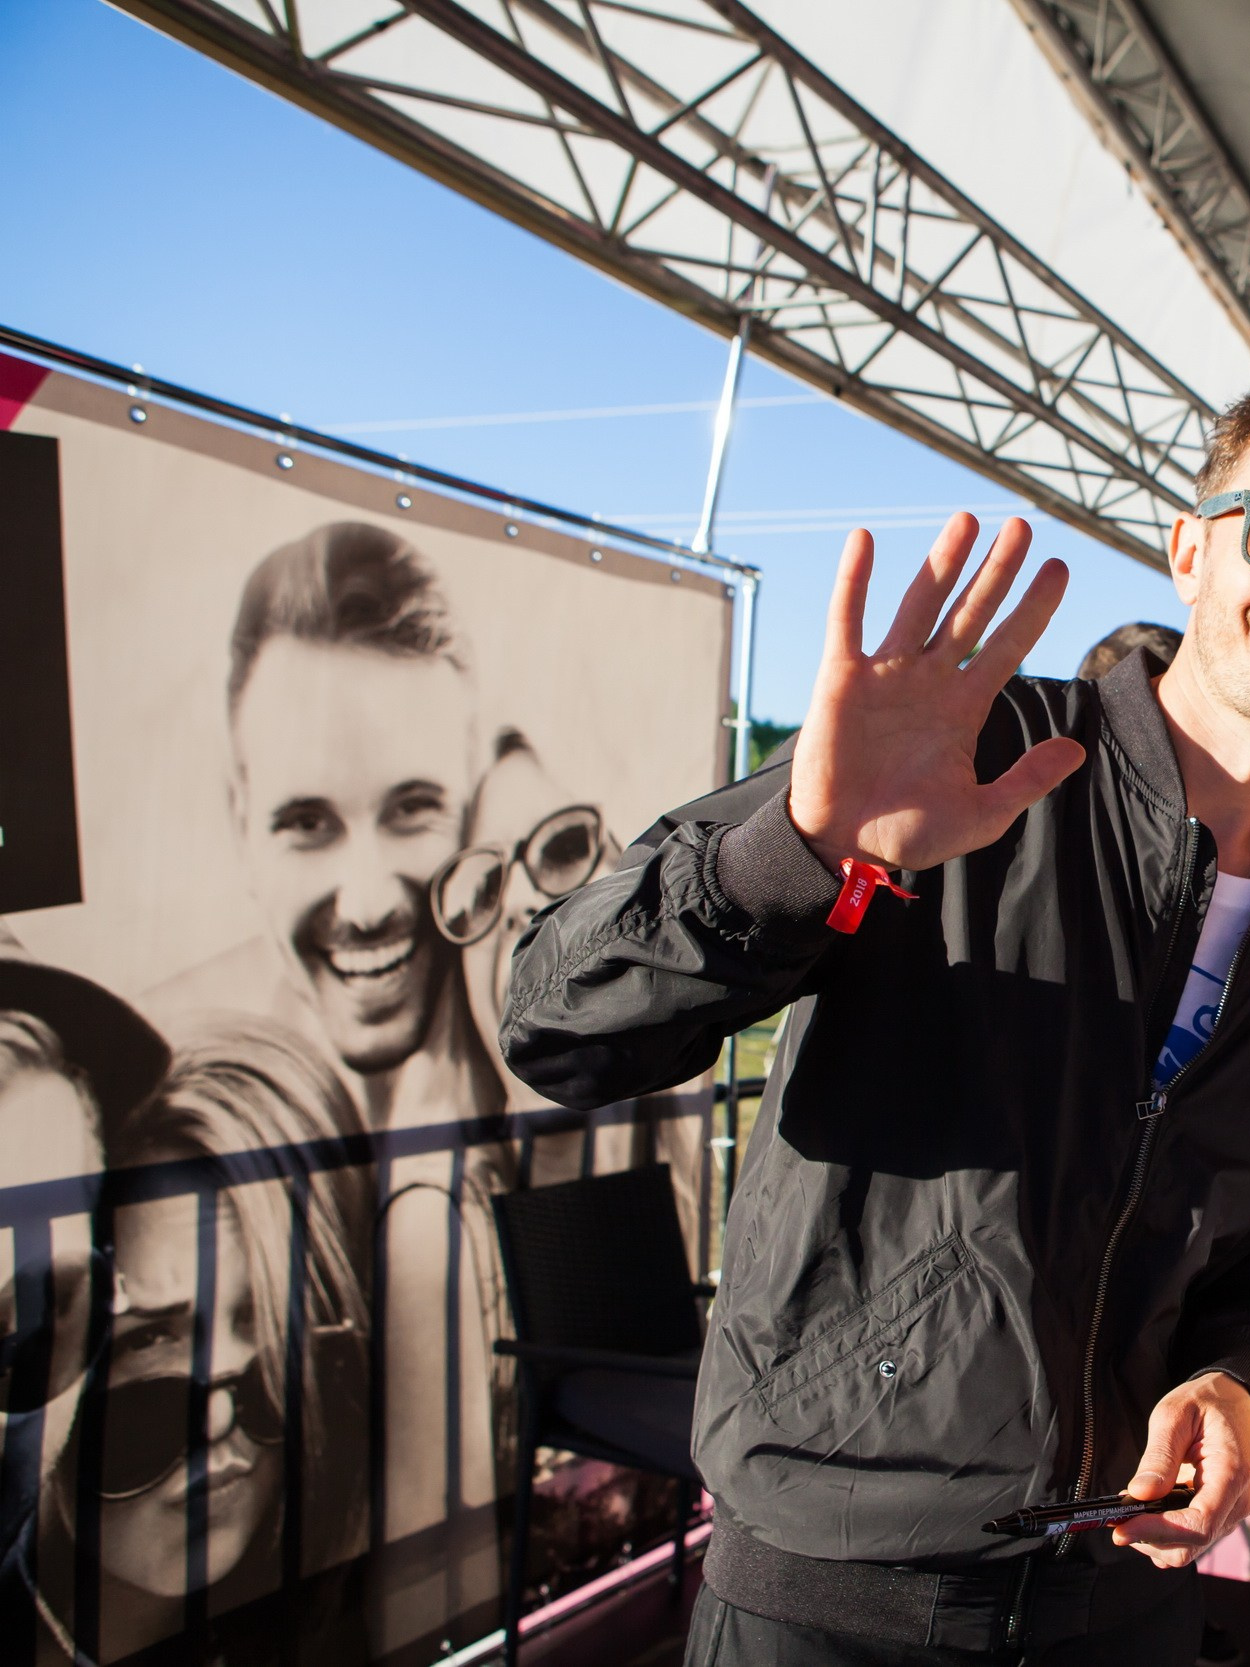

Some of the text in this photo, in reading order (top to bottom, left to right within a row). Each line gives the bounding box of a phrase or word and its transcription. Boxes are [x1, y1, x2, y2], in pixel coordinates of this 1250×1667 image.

[849, 877, 868, 908] 2018
[1073, 1503, 1146, 1520] МАРКЕР ПЕРМАНЕНТНЫЙ
